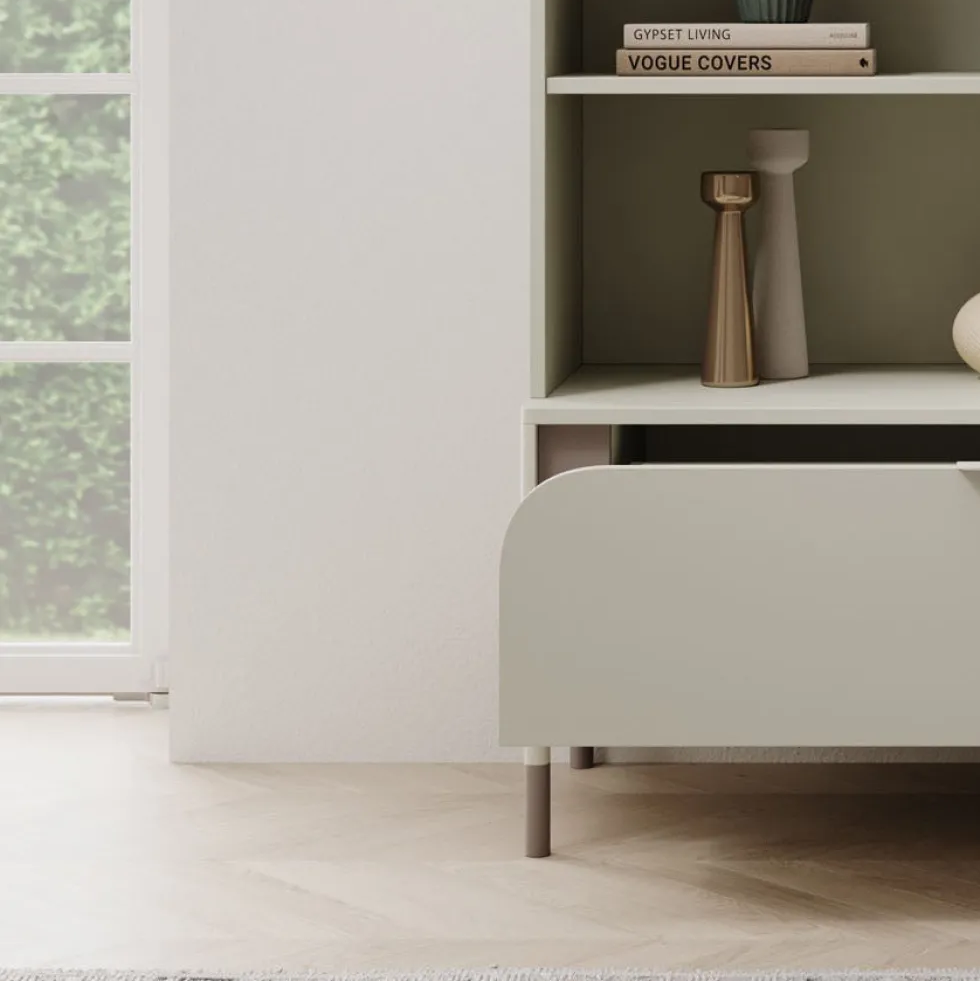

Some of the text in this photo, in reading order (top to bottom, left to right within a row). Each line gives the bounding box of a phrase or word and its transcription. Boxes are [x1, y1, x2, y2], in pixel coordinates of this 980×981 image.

[633, 28, 731, 40] GYPSET LIVING
[628, 55, 773, 71] VOGUE COVERS
